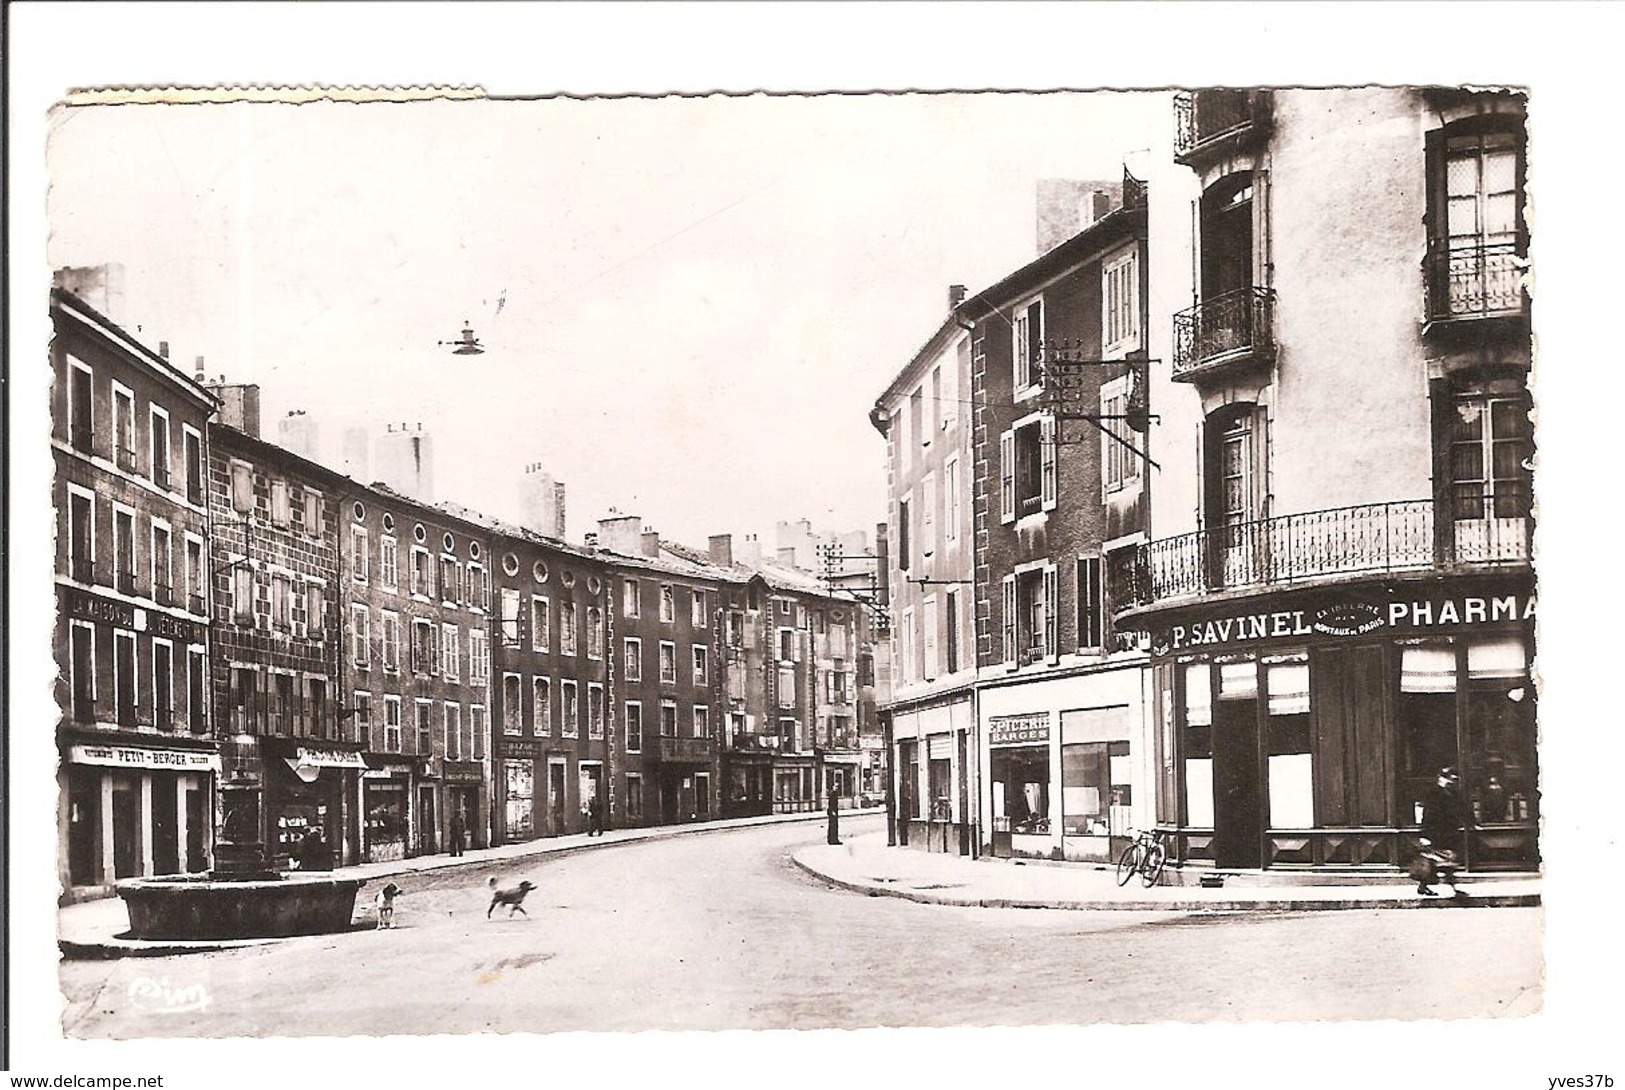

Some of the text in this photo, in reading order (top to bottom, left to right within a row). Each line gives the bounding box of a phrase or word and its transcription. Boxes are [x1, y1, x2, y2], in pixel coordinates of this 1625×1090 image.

[1358, 616, 1385, 634] PARIS
[989, 716, 1050, 733] EPICERIE
[992, 729, 1048, 742] BARGES
[118, 750, 144, 762] PETIT
[153, 752, 187, 766] BERGER
